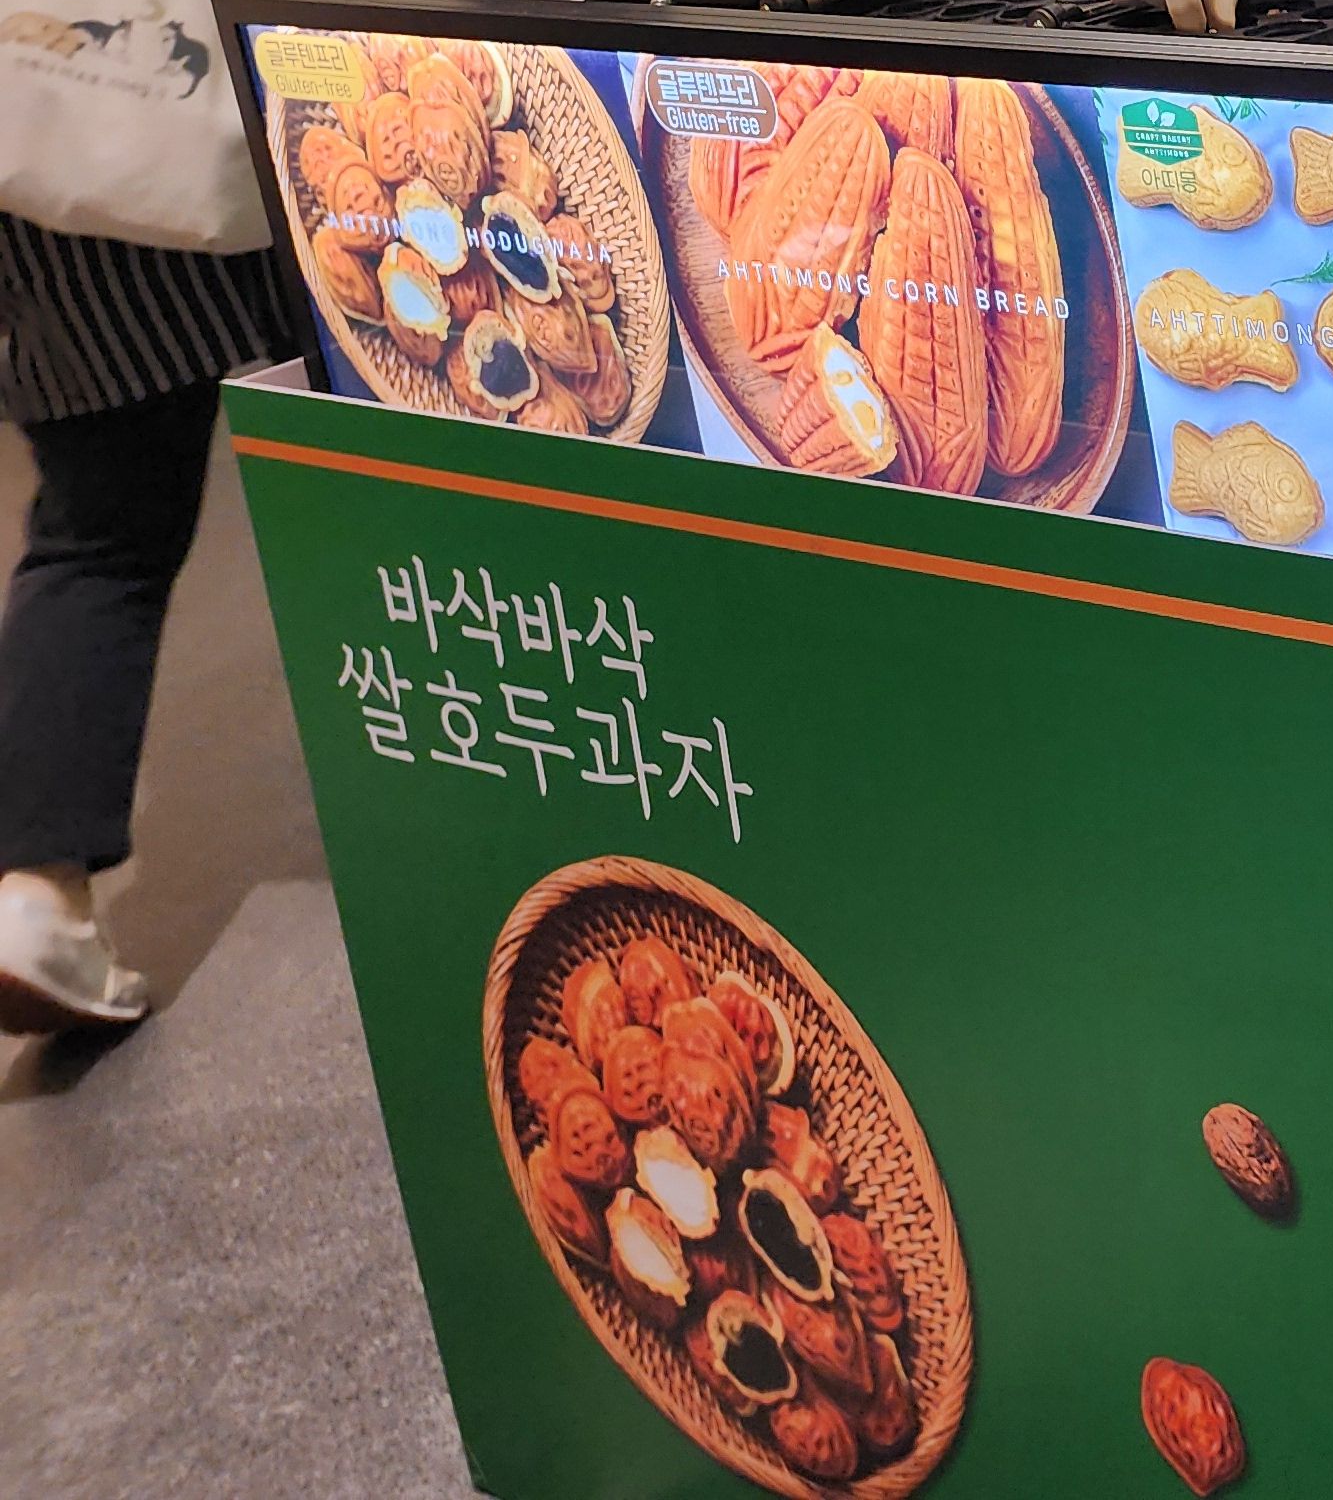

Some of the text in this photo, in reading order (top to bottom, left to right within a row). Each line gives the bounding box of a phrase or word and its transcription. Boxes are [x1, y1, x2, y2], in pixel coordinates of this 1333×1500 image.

[264, 39, 348, 73] 글루텐프리
[275, 74, 353, 99] Gluten-free
[656, 68, 758, 107] 글루텐프리
[667, 107, 760, 135] Gluten-free
[1162, 135, 1191, 144] BAKERY
[1142, 168, 1197, 193] 아띠몽
[466, 226, 612, 265] HODUGWAJA
[717, 258, 1070, 320] AHTTIMONG CORN BREAD
[377, 555, 655, 701] 바삭바삭
[338, 643, 754, 844] 쌀호두과자
